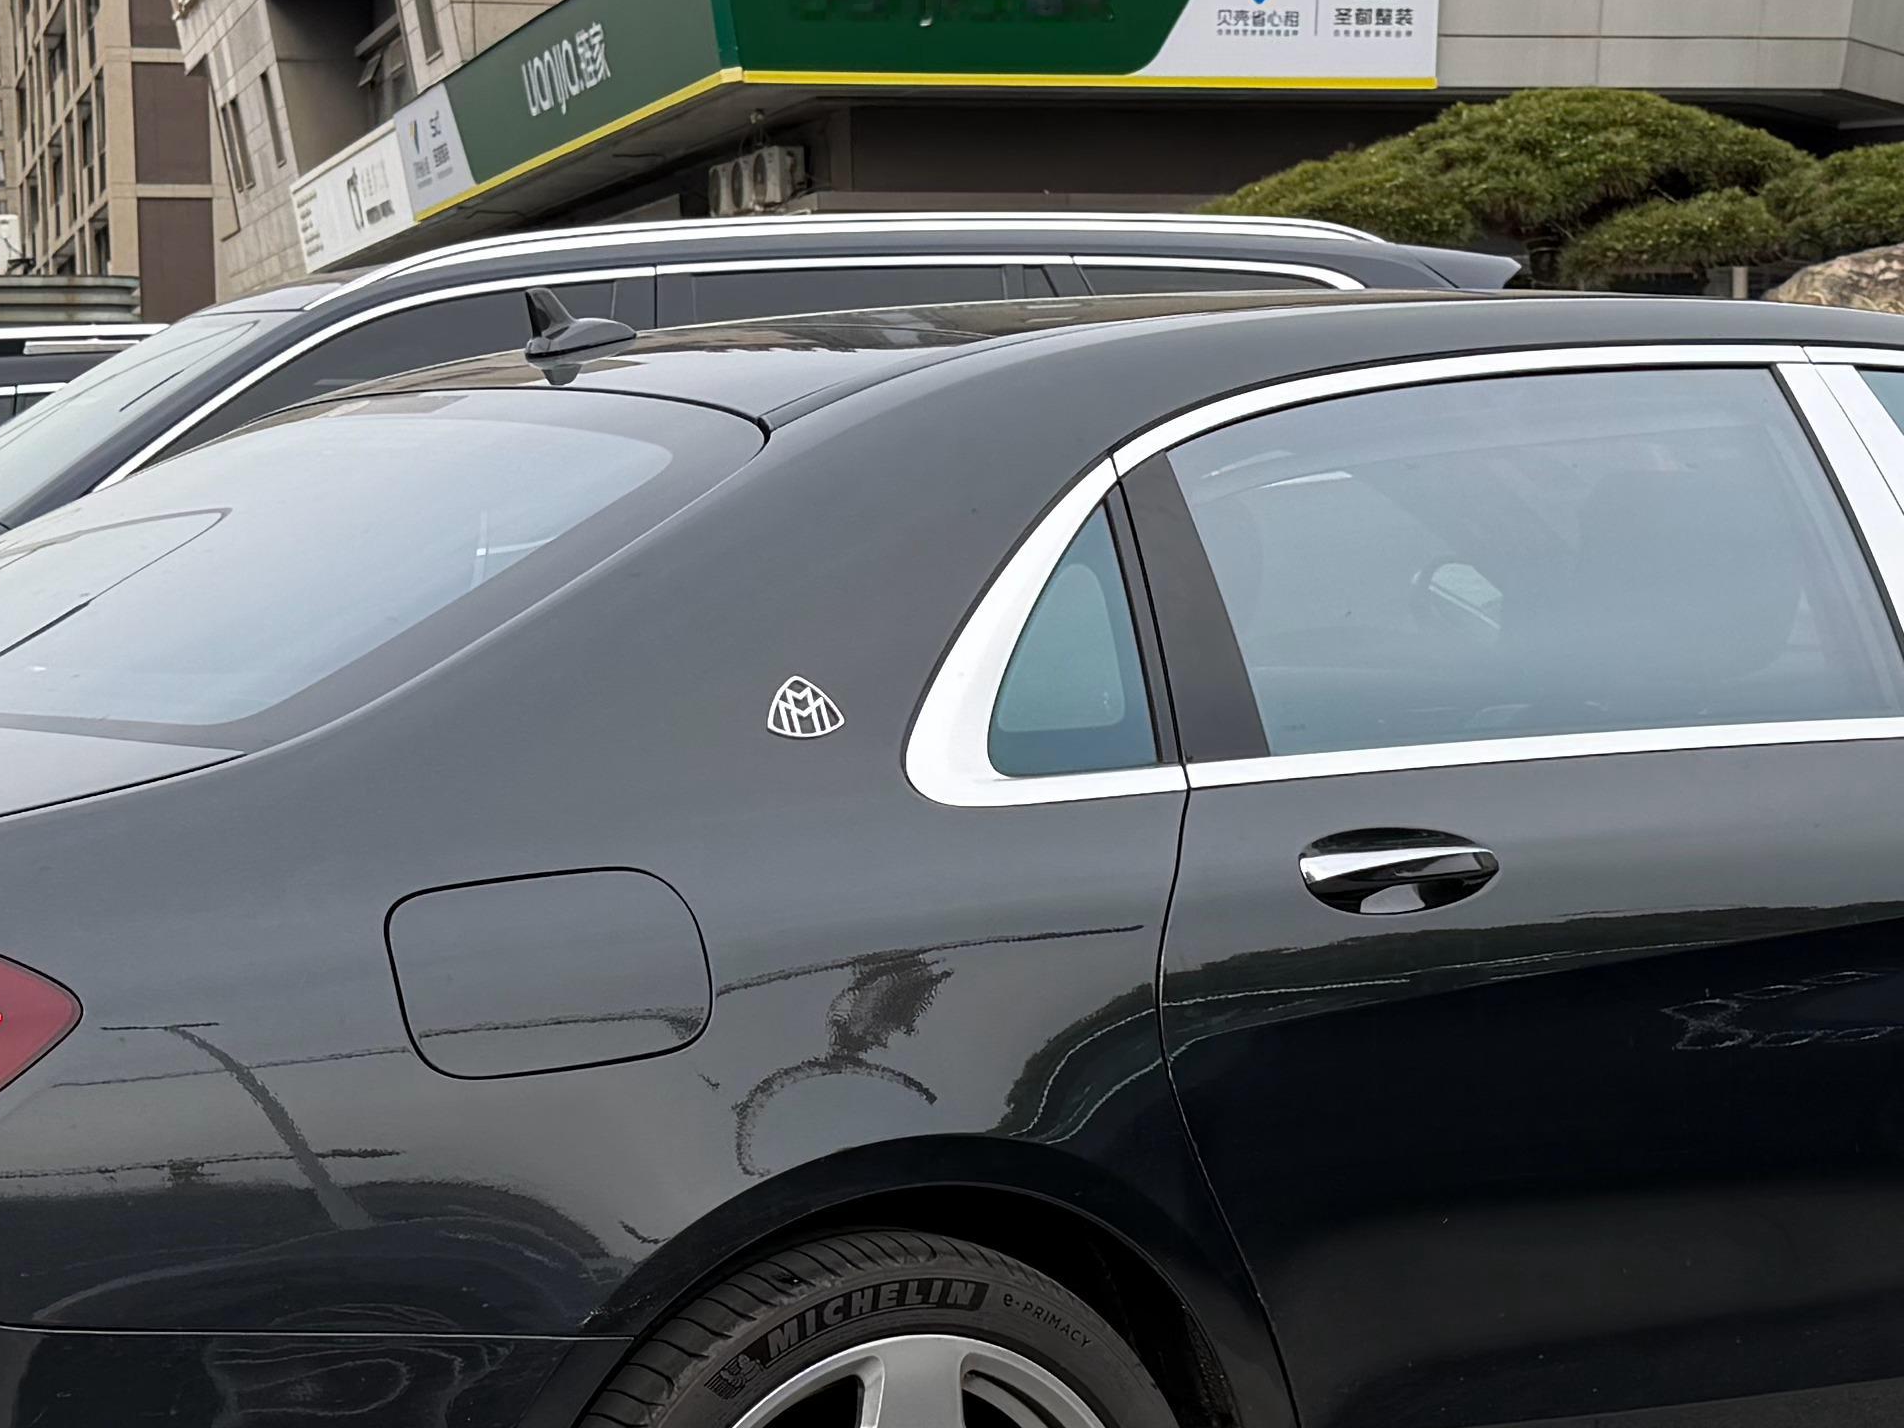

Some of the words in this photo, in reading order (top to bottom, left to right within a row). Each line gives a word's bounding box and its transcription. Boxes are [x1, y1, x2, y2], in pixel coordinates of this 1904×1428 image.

[1216, 9, 1300, 28] 贝壳省心租
[766, 1278, 978, 1359] MICHELIN
[1002, 1291, 1093, 1349] e-PRIMACY
